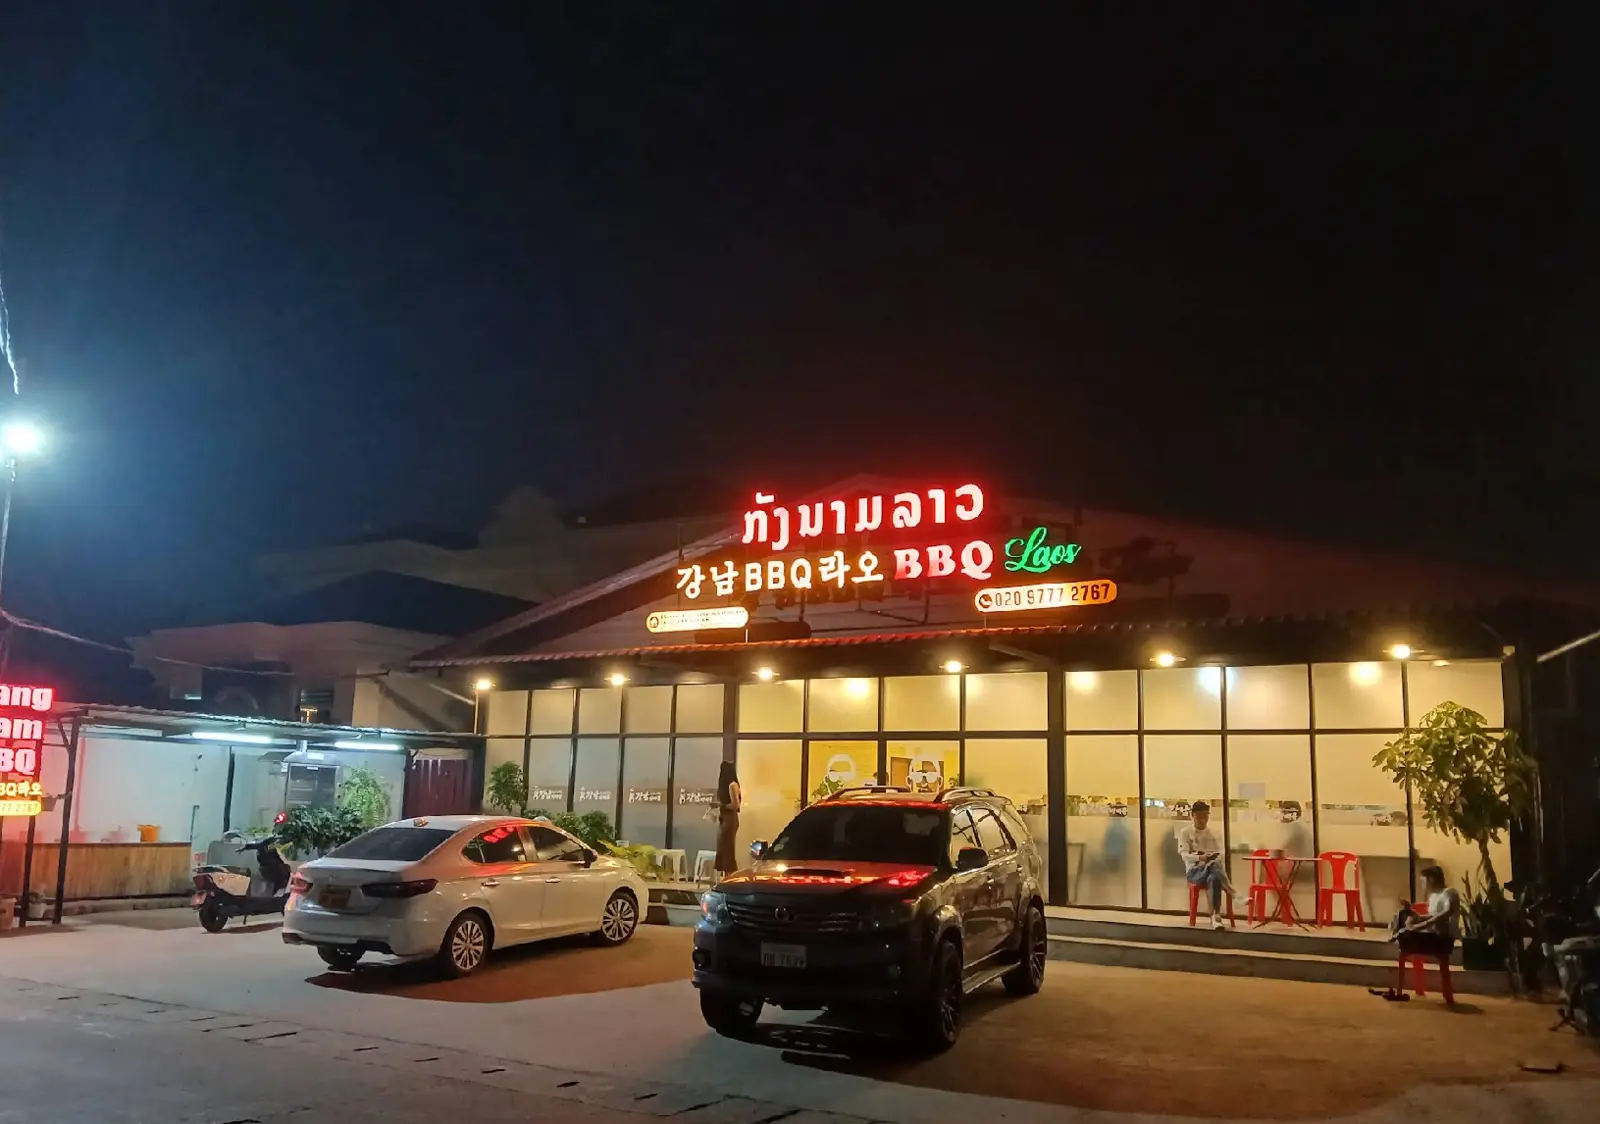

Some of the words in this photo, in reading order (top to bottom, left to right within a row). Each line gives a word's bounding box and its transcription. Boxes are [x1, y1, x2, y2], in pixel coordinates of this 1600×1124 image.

[742, 483, 984, 551] ກັງນາມລາວ
[893, 540, 994, 580] BBQ
[1004, 527, 1081, 573] Laos
[995, 590, 1022, 607] 020
[1026, 587, 1064, 605] 9777
[1071, 583, 1111, 601] 2767
